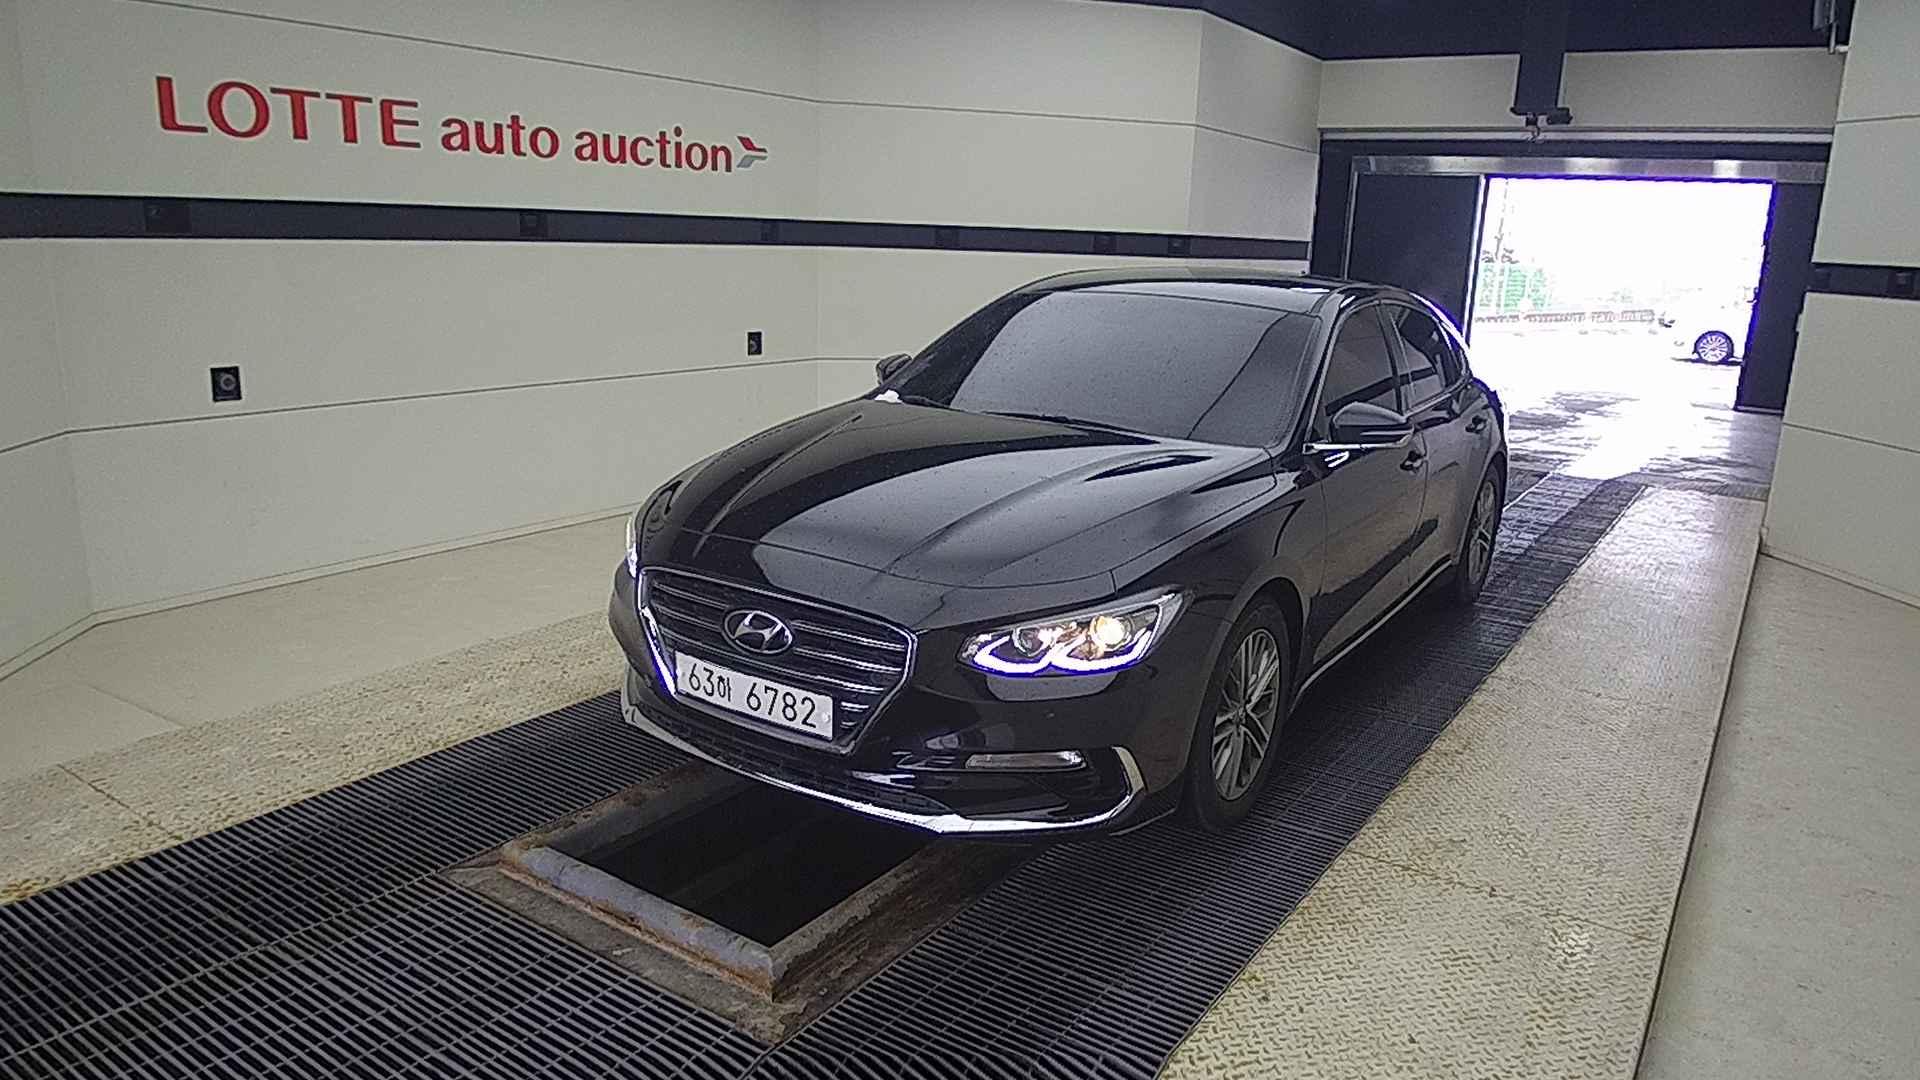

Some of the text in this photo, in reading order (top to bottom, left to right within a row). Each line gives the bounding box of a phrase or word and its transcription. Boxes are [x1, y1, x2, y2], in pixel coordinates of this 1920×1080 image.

[156, 76, 732, 173] LOTTE auto auction
[688, 663, 817, 728] 63하 6782
